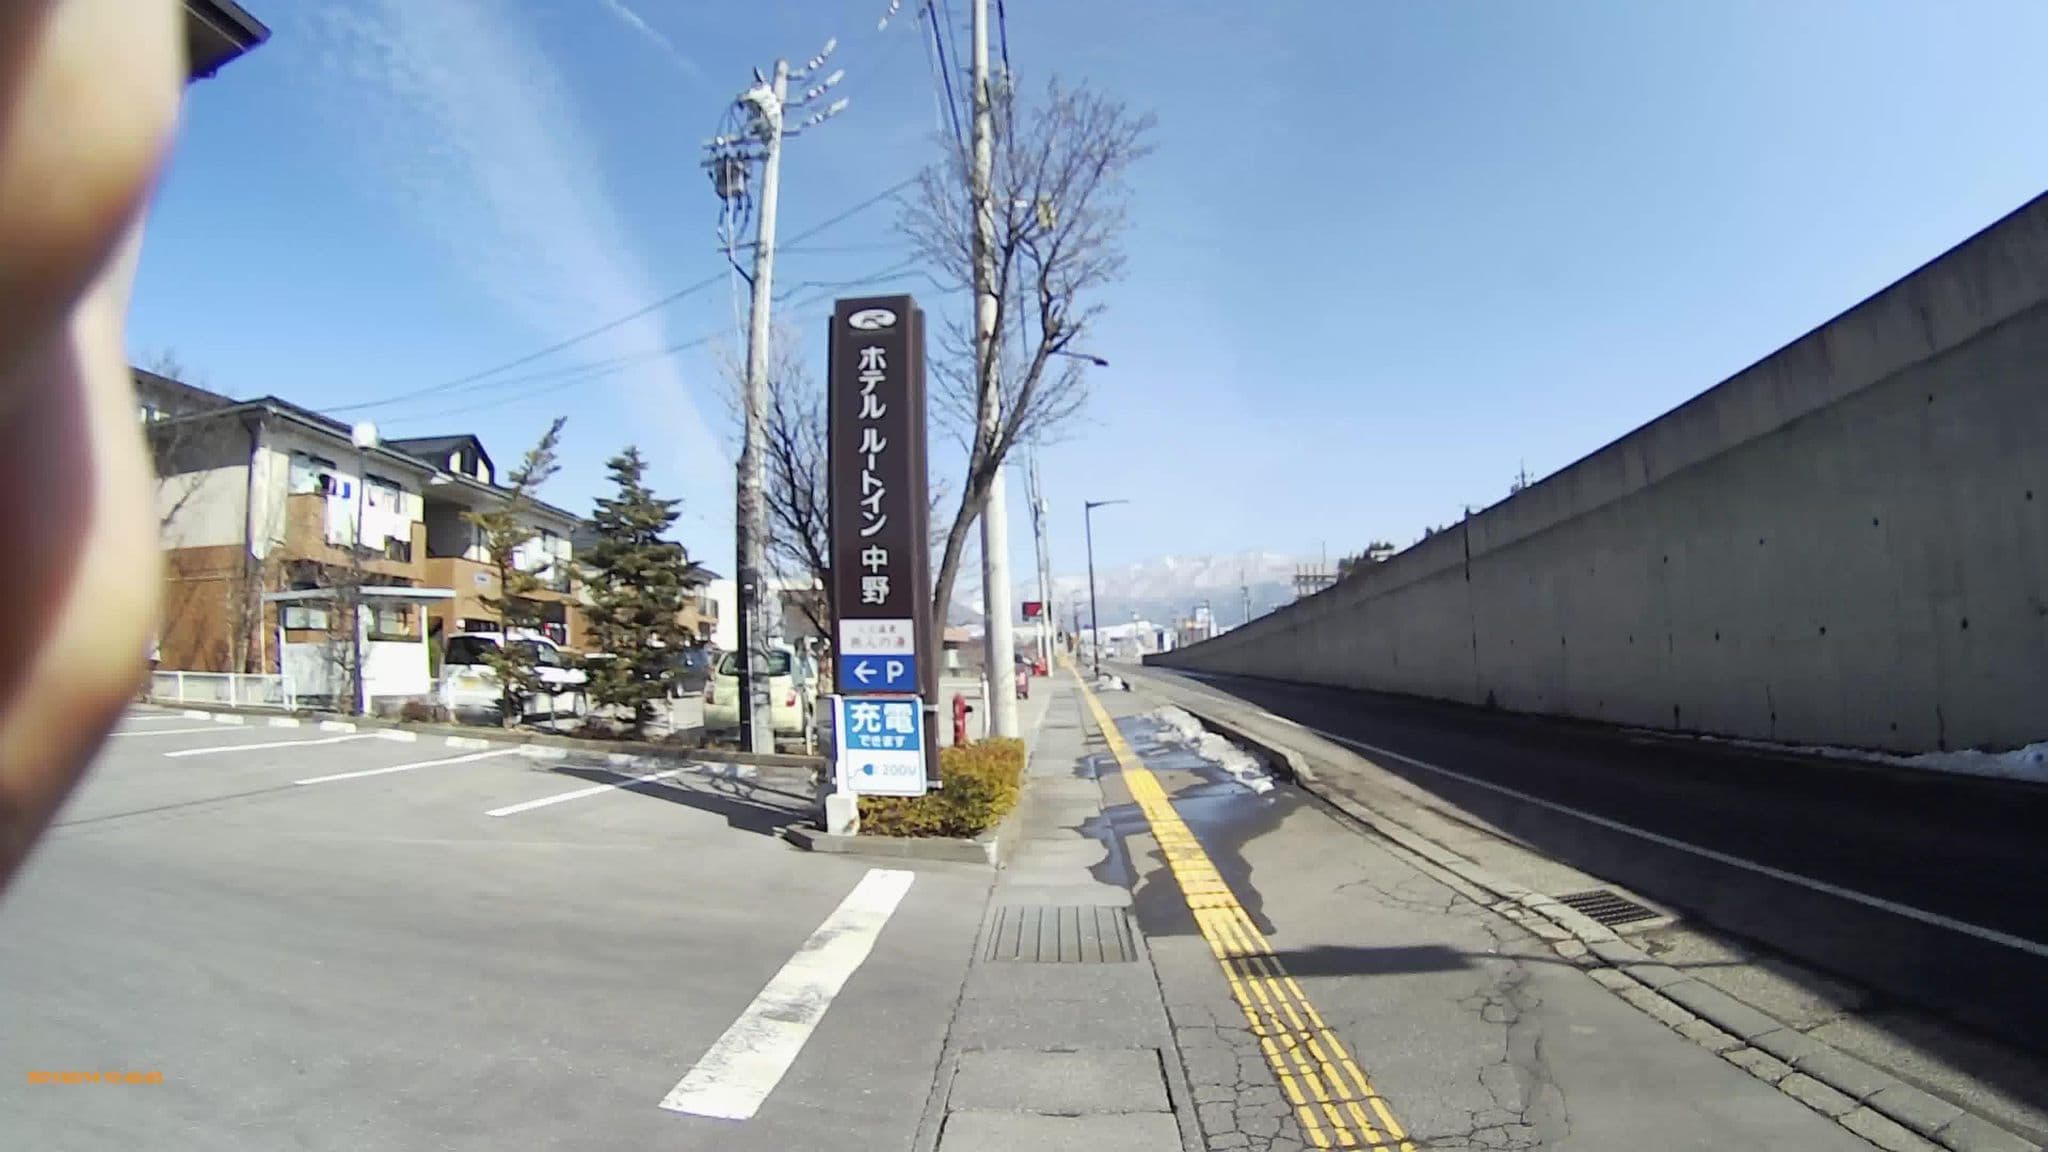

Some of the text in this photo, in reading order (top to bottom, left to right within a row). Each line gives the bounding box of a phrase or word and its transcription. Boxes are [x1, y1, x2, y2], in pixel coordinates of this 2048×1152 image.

[857, 346, 888, 420] ホテル
[858, 427, 889, 538] ルートイン
[861, 545, 891, 606] 中野
[886, 660, 905, 685] P
[850, 702, 915, 734] 充電
[857, 734, 907, 748] できます
